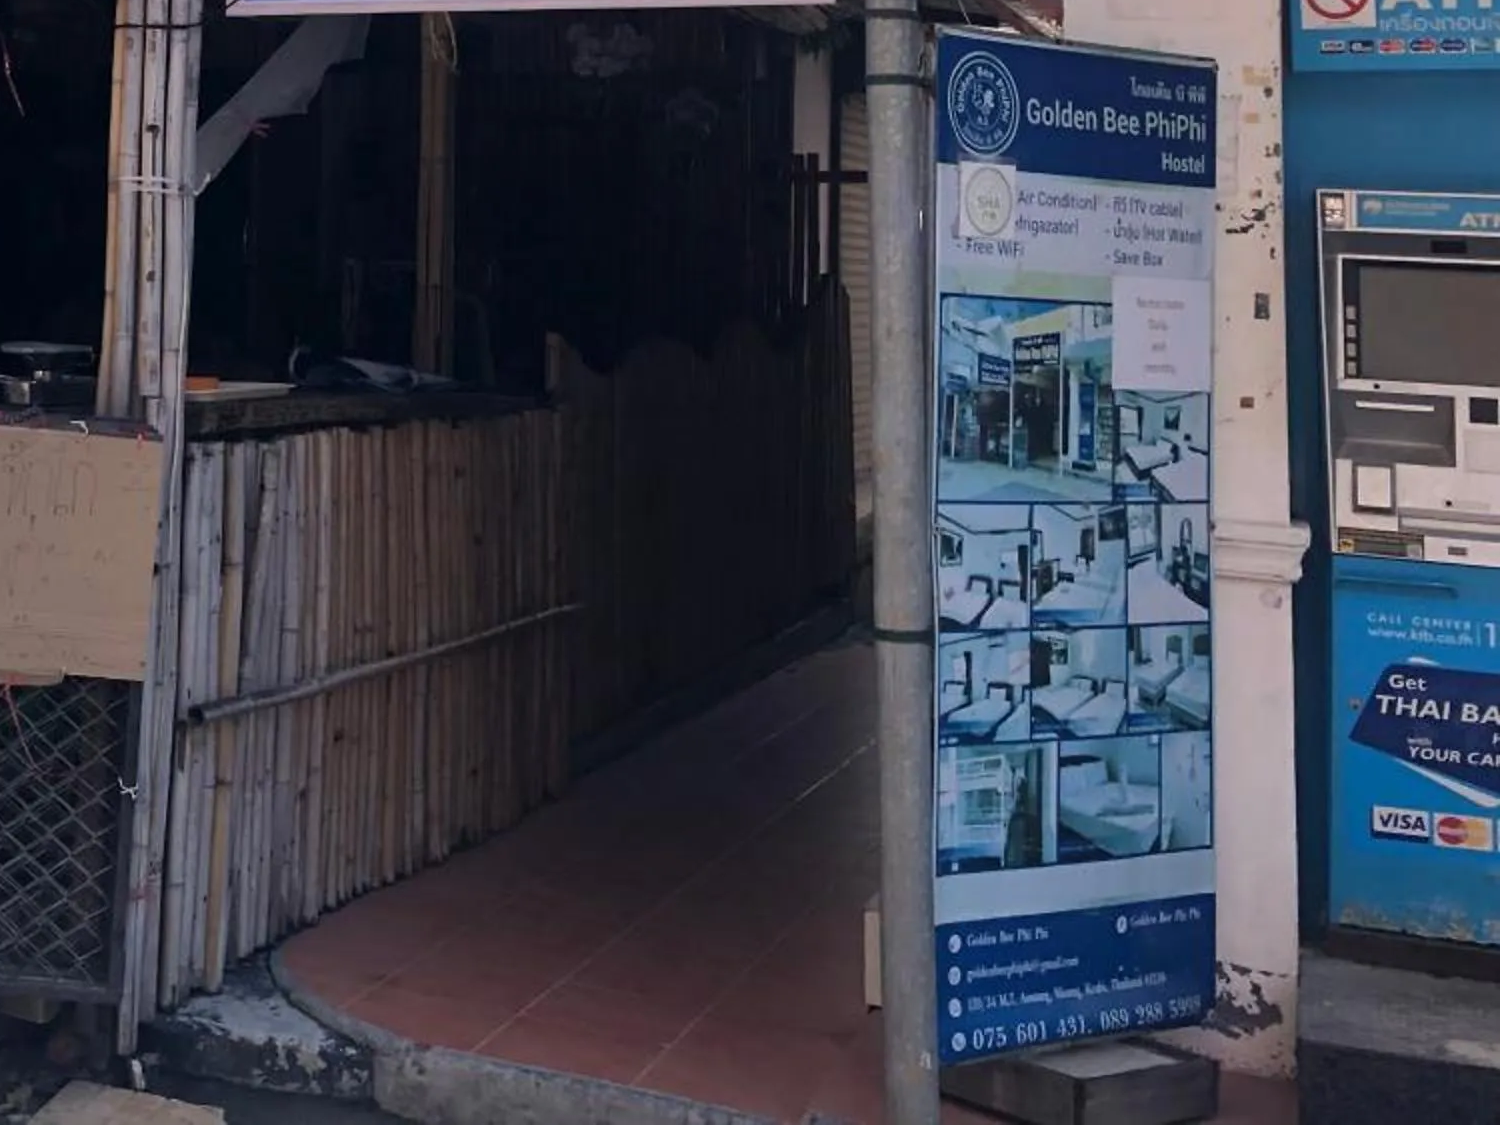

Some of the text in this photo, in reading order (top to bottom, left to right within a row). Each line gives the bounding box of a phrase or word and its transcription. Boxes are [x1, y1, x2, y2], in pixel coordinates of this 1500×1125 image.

[1027, 98, 1207, 143] Golden Bee PhiPhi
[1161, 152, 1205, 174] Hostel
[1367, 612, 1472, 632] CALL CENTER
[1388, 674, 1428, 692] Get
[1376, 694, 1500, 725] THAI BA
[1409, 746, 1461, 764] YOUR
[1379, 811, 1427, 831] VISA
[973, 1027, 1007, 1050] 075
[1016, 1020, 1047, 1045] 601
[1100, 1008, 1129, 1031] 089
[1135, 1002, 1163, 1025] 288
